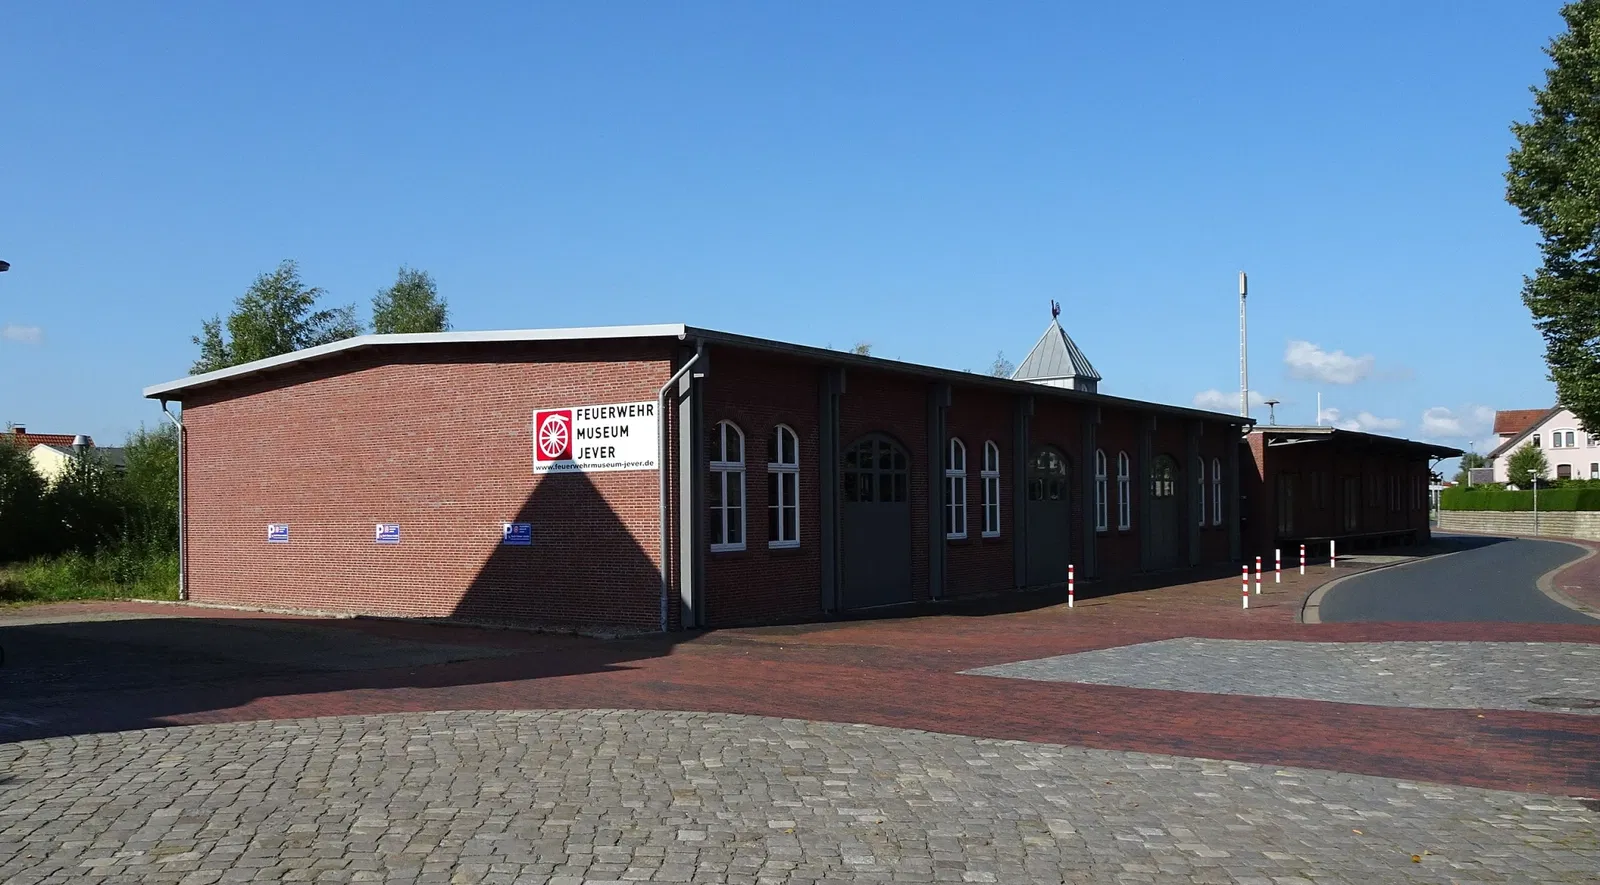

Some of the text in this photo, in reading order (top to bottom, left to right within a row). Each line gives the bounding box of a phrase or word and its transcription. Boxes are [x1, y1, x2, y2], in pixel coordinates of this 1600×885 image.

[577, 404, 654, 421] FEUERWEHR
[577, 425, 629, 440] MUSEUM
[578, 446, 615, 459] JEVER
[536, 460, 654, 470] www.feuerwehrmuseum-jever.de
[268, 524, 275, 539] P
[376, 524, 383, 539] P
[503, 524, 512, 539] P
